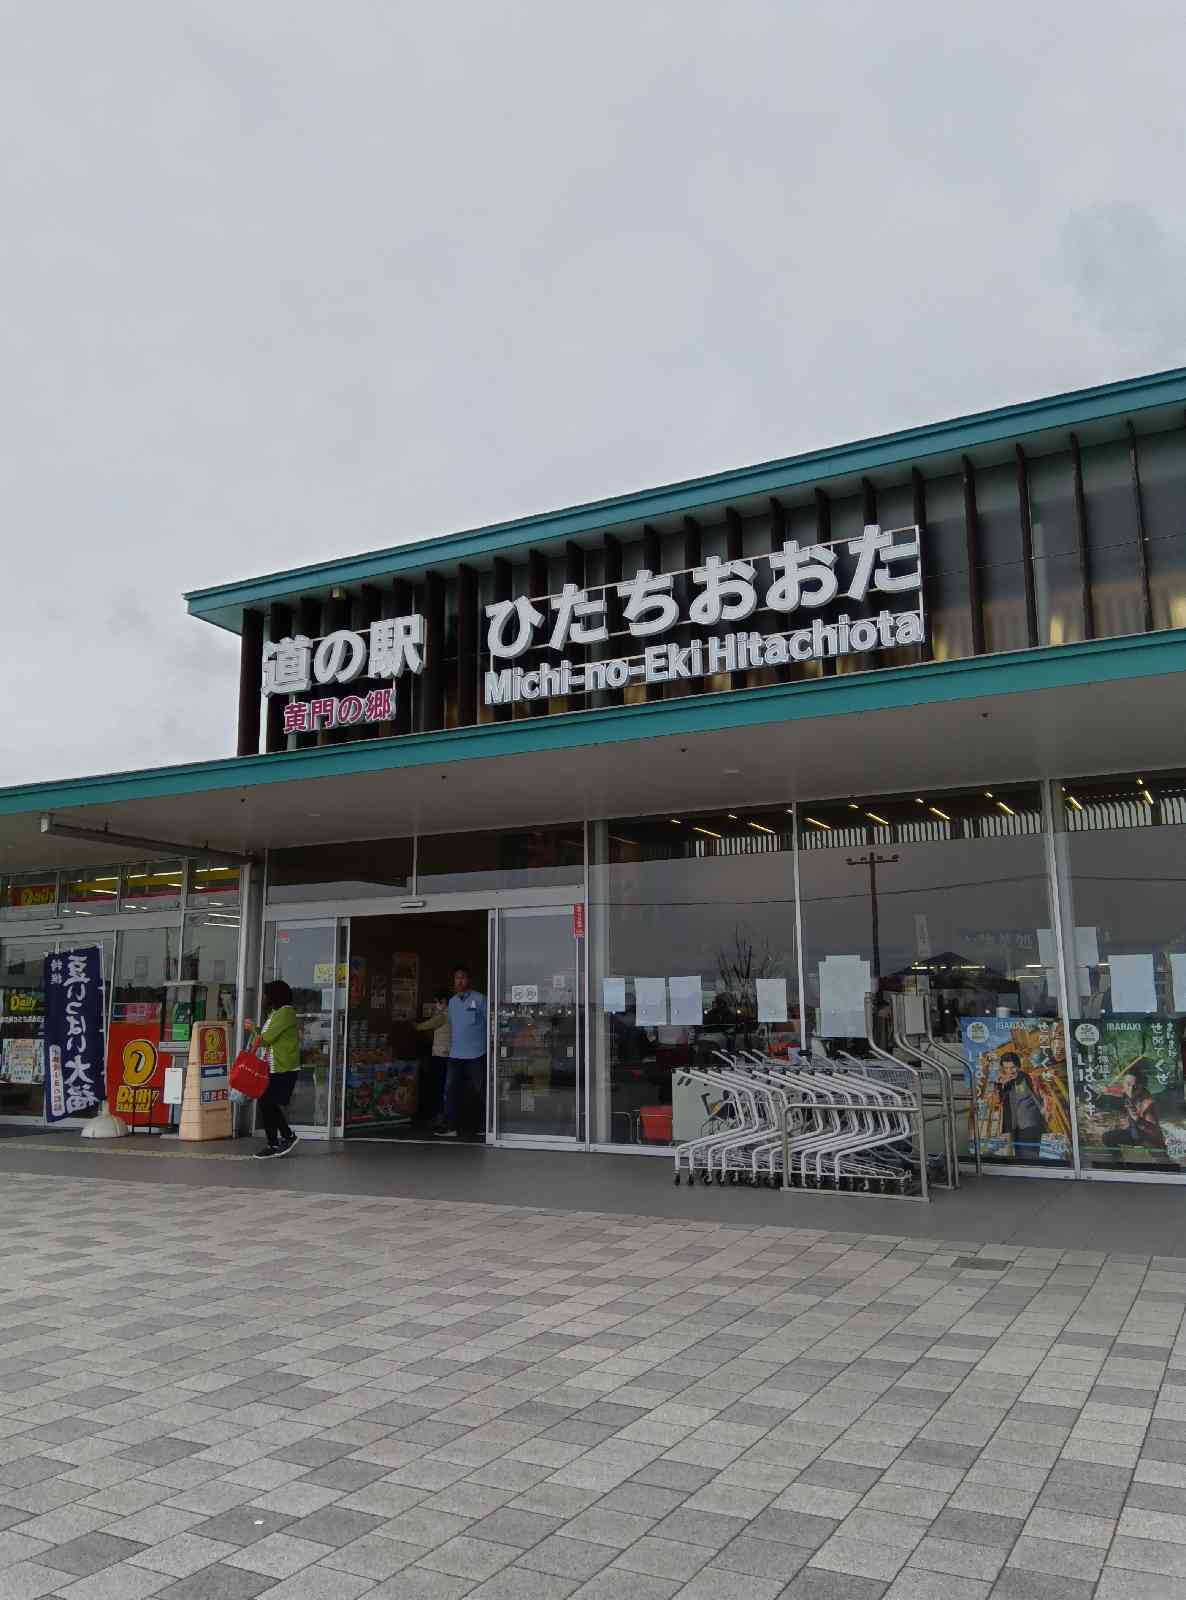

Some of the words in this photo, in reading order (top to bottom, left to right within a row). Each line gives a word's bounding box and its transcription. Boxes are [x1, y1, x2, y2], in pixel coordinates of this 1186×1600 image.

[486, 525, 922, 658] ひたちおおた
[262, 613, 425, 698] 道の駅
[485, 638, 703, 705] Michi-no-Eki
[708, 610, 924, 673] Hitachiota
[284, 688, 396, 734] 黄門の郷
